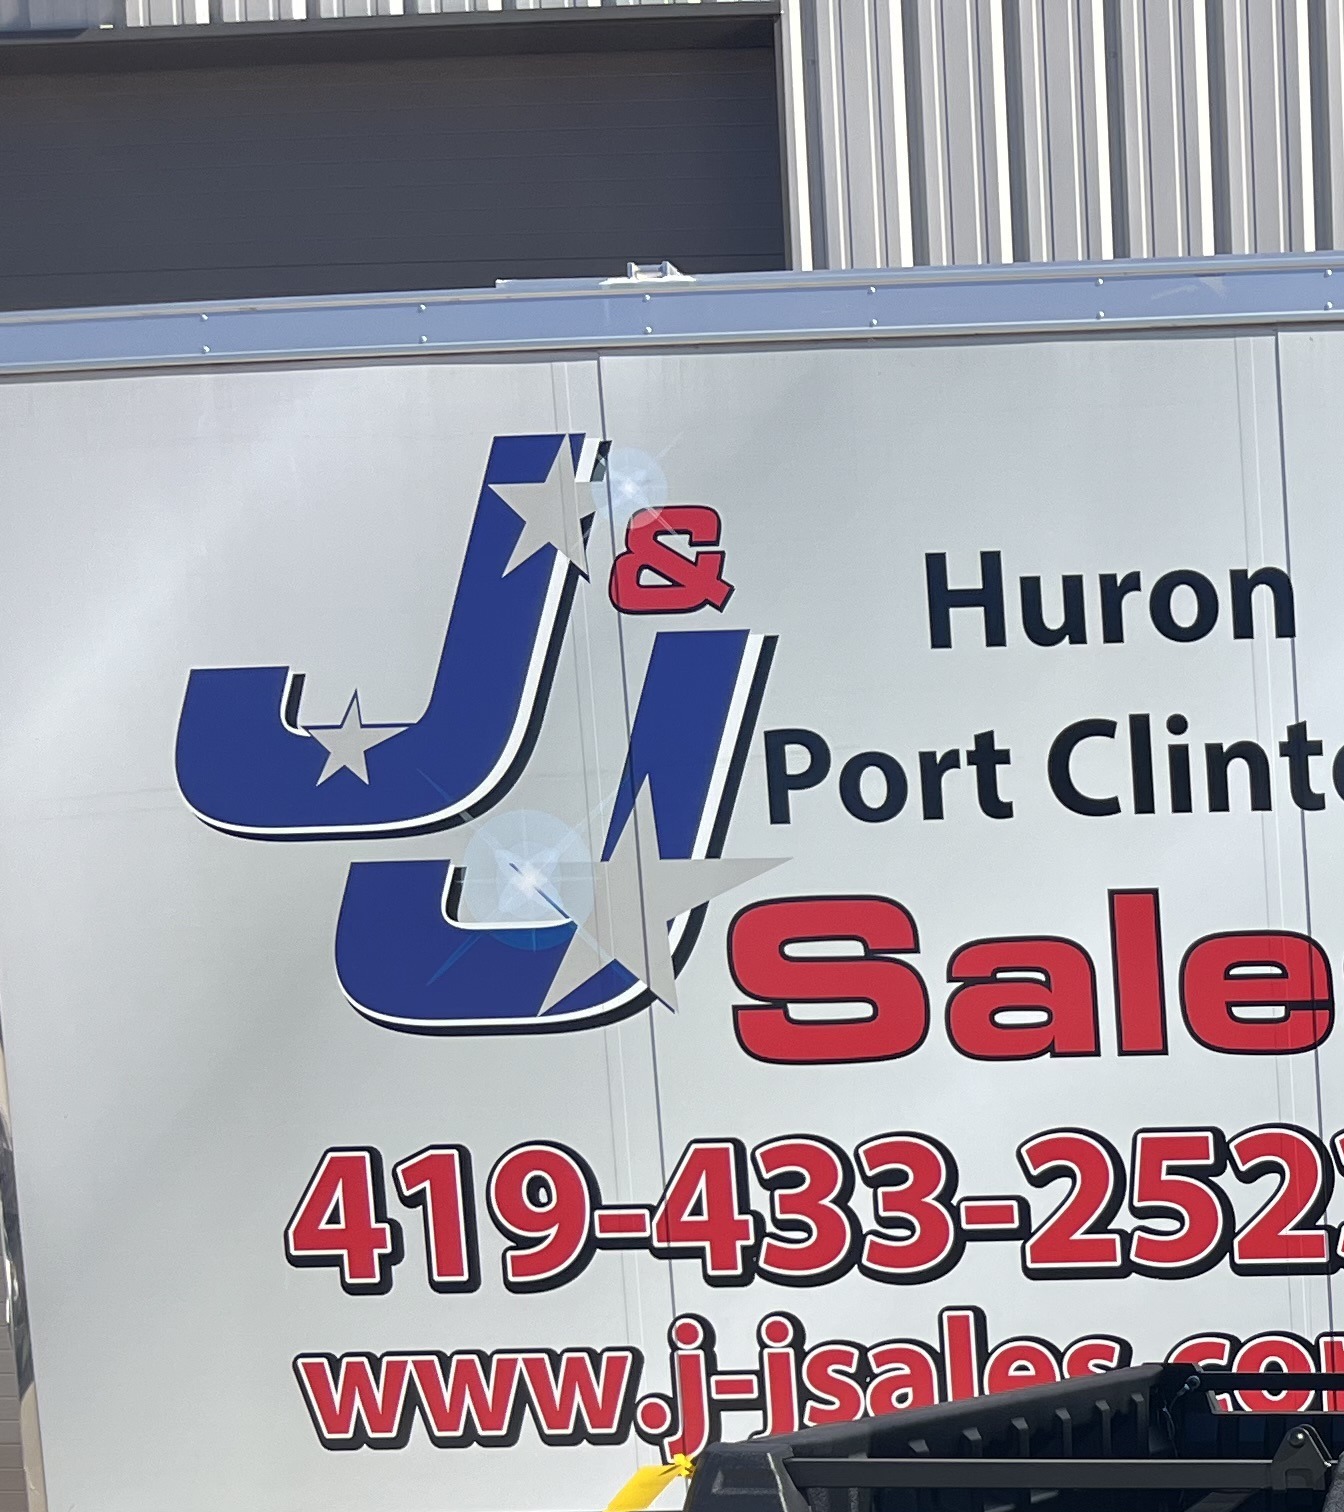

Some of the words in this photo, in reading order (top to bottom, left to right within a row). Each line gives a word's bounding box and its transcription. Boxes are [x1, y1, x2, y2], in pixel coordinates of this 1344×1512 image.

[609, 504, 735, 615] &
[924, 549, 1297, 650] Huron
[763, 728, 1014, 825] Port
